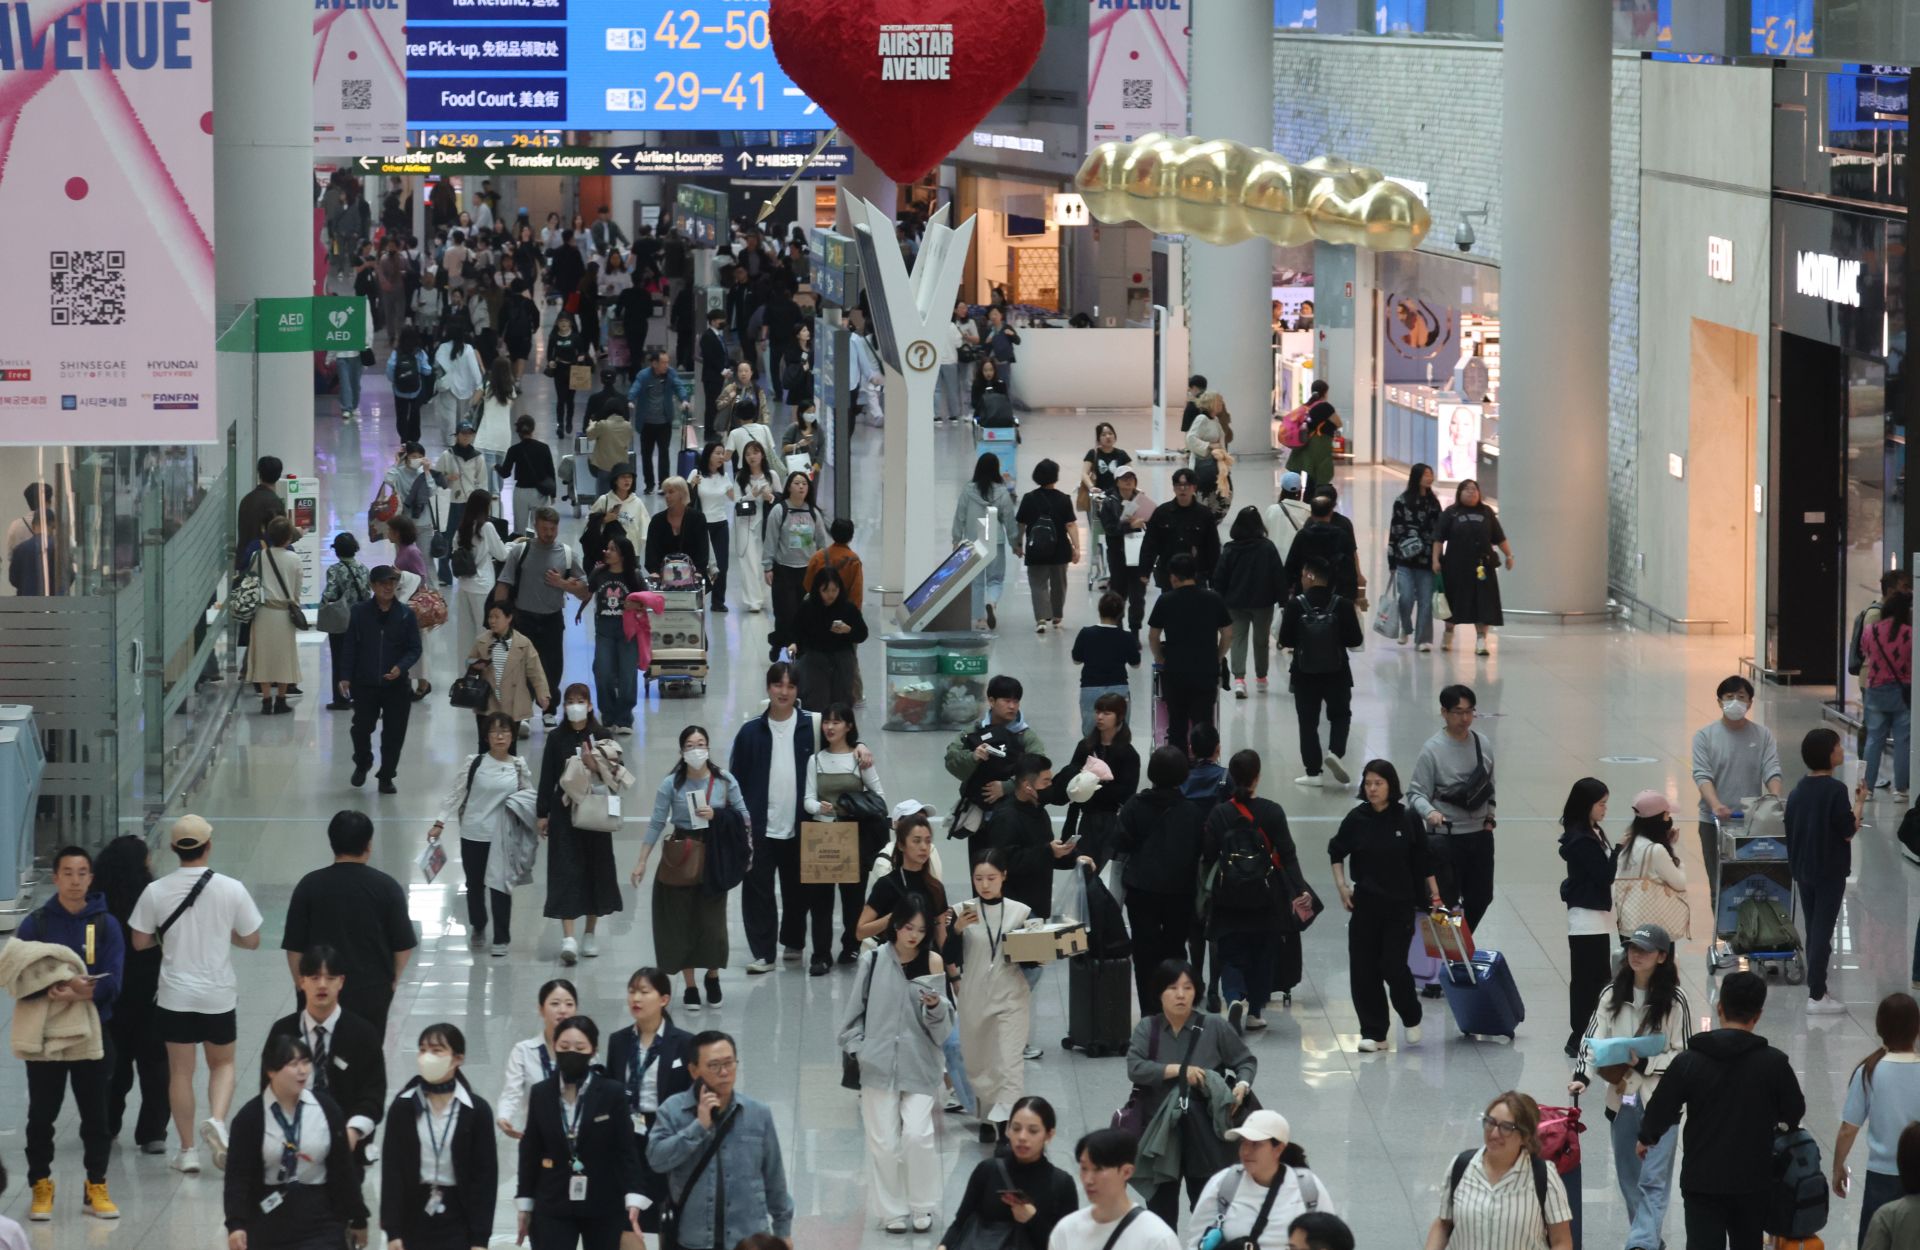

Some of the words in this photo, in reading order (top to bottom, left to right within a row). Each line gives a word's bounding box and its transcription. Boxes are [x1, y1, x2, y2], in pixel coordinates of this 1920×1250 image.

[0, 1, 192, 70] AVENUE
[654, 10, 769, 49] 42-50
[406, 44, 427, 56] ree
[428, 41, 480, 60] Pick-up,
[878, 32, 953, 56] AIRSTAR
[882, 57, 950, 80] AVENUE
[441, 90, 475, 107] Food
[477, 91, 517, 108] Court,
[519, 91, 559, 108] 美食街
[654, 72, 765, 110] 29-41
[438, 134, 479, 148] 42-50
[435, 151, 467, 164] Desk
[508, 153, 555, 168] Transfer
[556, 154, 600, 170] Lounge
[634, 150, 674, 164] Airline
[675, 150, 724, 166] Lounges
[381, 164, 403, 173] Other
[278, 313, 304, 326] AED
[326, 331, 351, 341] AED
[60, 361, 126, 369] SHINSEGAE
[147, 360, 198, 369] HYUNDAI
[153, 393, 199, 401] FANFAN
